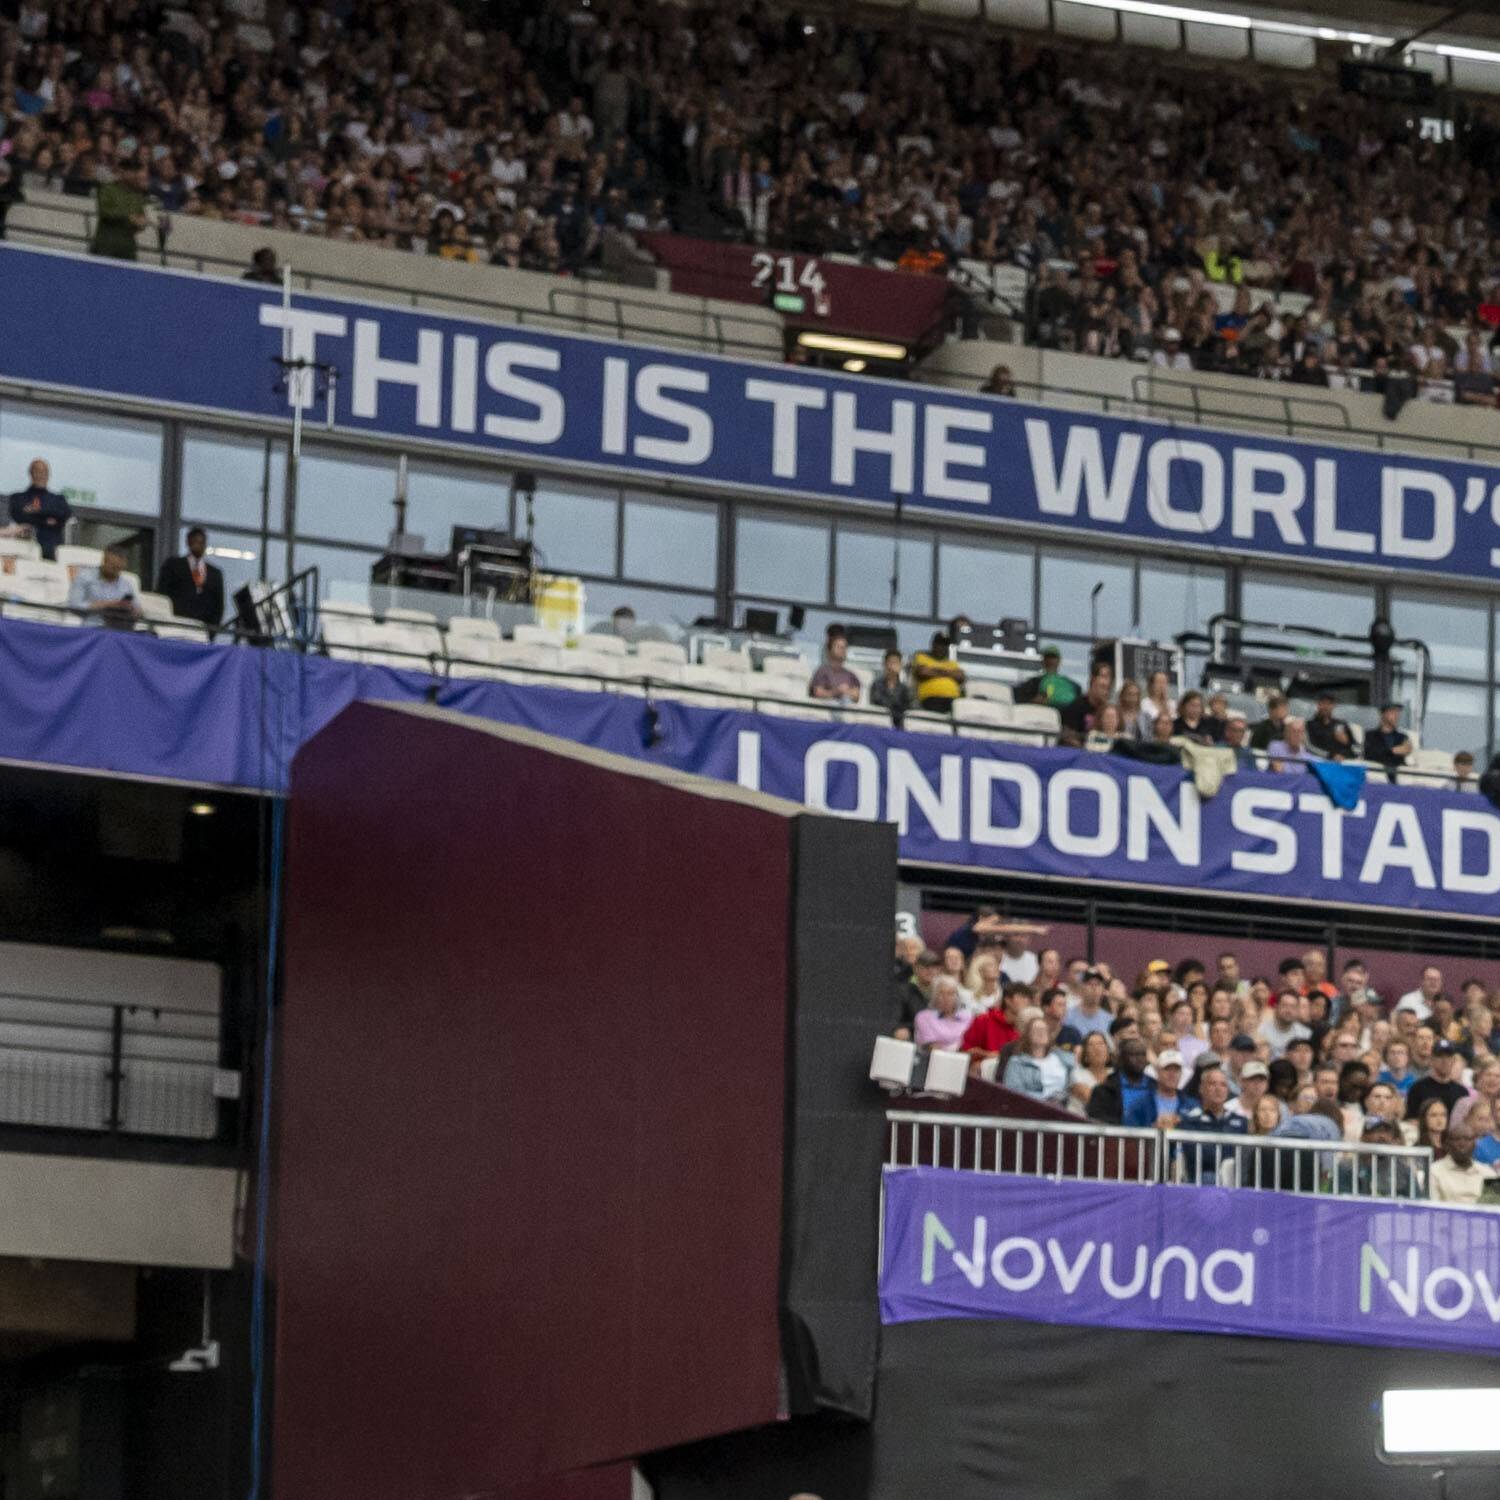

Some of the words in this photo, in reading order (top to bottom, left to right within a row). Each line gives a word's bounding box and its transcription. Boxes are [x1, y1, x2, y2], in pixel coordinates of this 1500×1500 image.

[751, 252, 826, 296] 214
[259, 303, 566, 446] THIS
[602, 357, 714, 465] IS
[745, 378, 994, 504] THE
[921, 1211, 1256, 1306] Novuna
